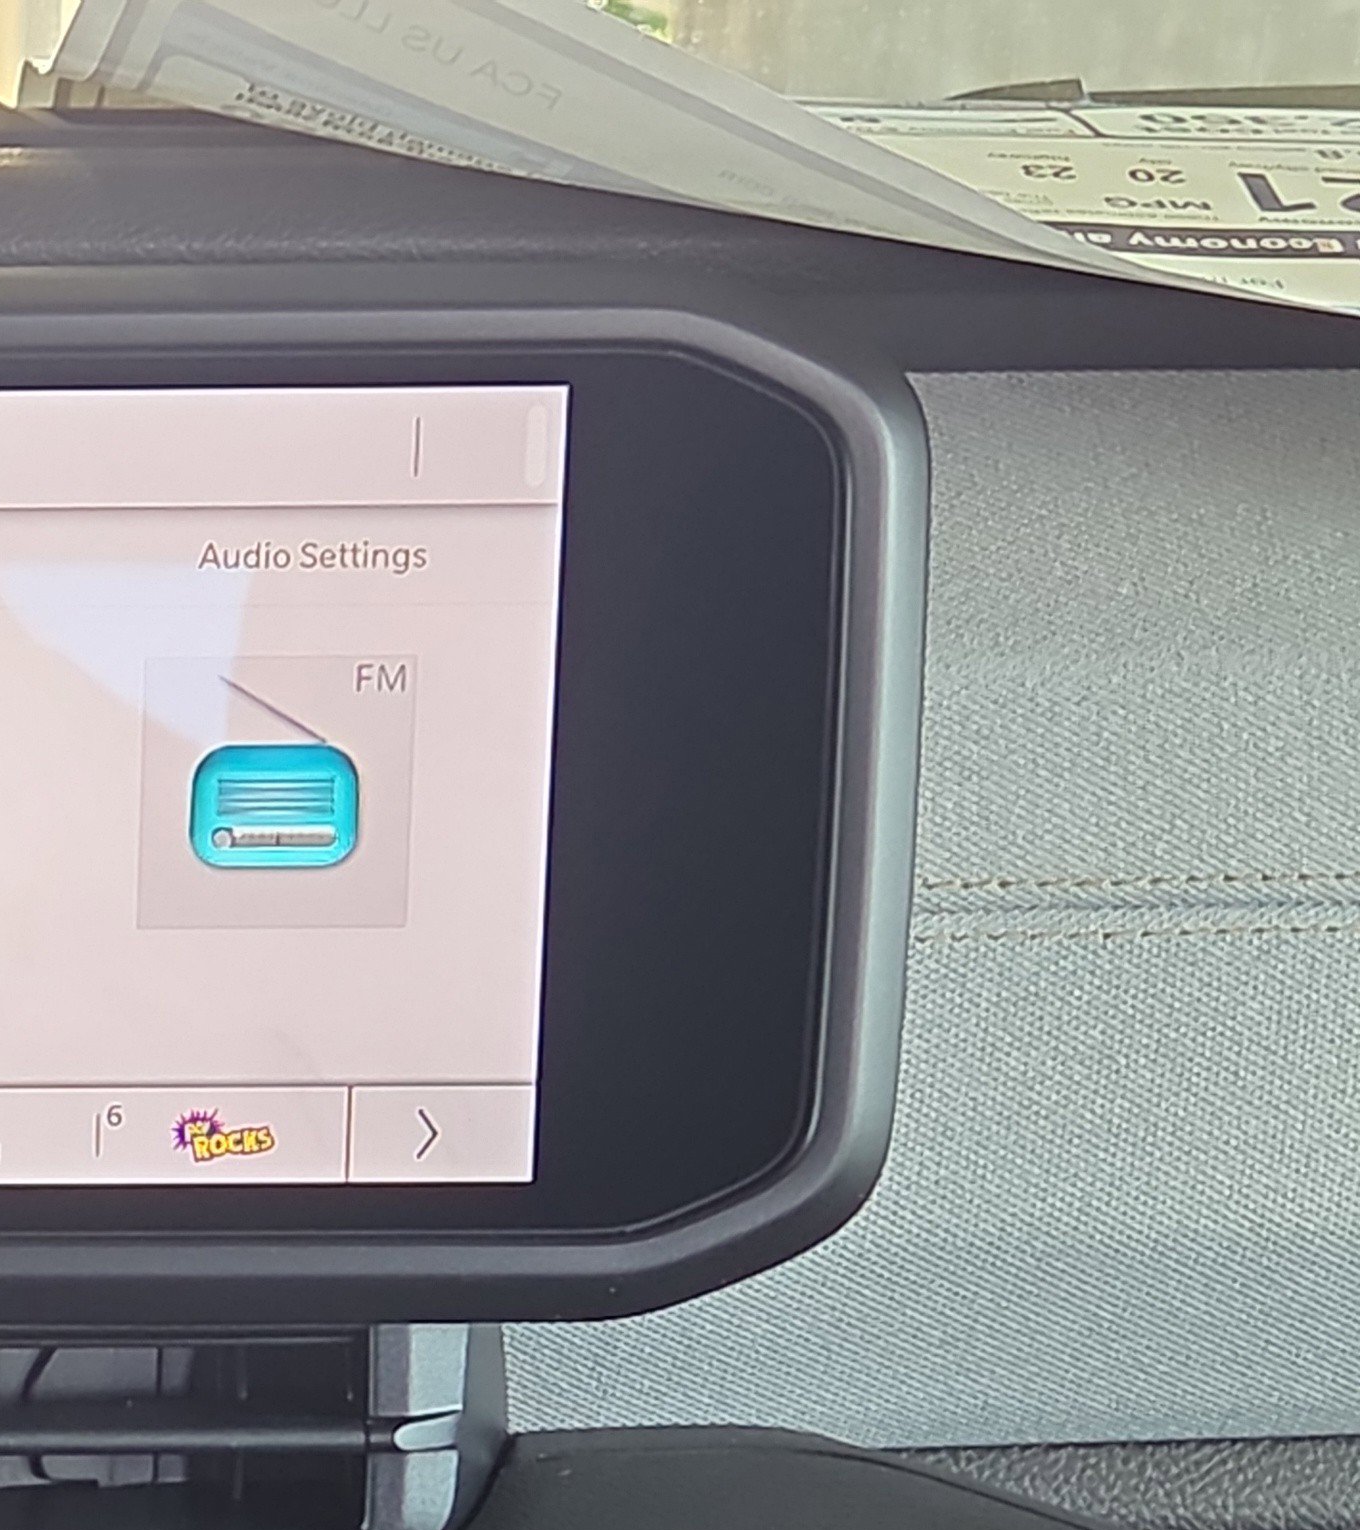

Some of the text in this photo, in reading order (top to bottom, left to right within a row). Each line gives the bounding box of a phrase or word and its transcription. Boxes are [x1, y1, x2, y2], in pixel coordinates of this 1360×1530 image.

[1020, 163, 1077, 181] 23
[1128, 168, 1186, 185] 20
[1103, 196, 1212, 211] MPG
[1128, 230, 1345, 254] Economy
[198, 541, 429, 576] Audio Settings
[355, 664, 408, 694] FM
[106, 1105, 123, 1126] 6
[191, 1125, 276, 1162] ROCKS
